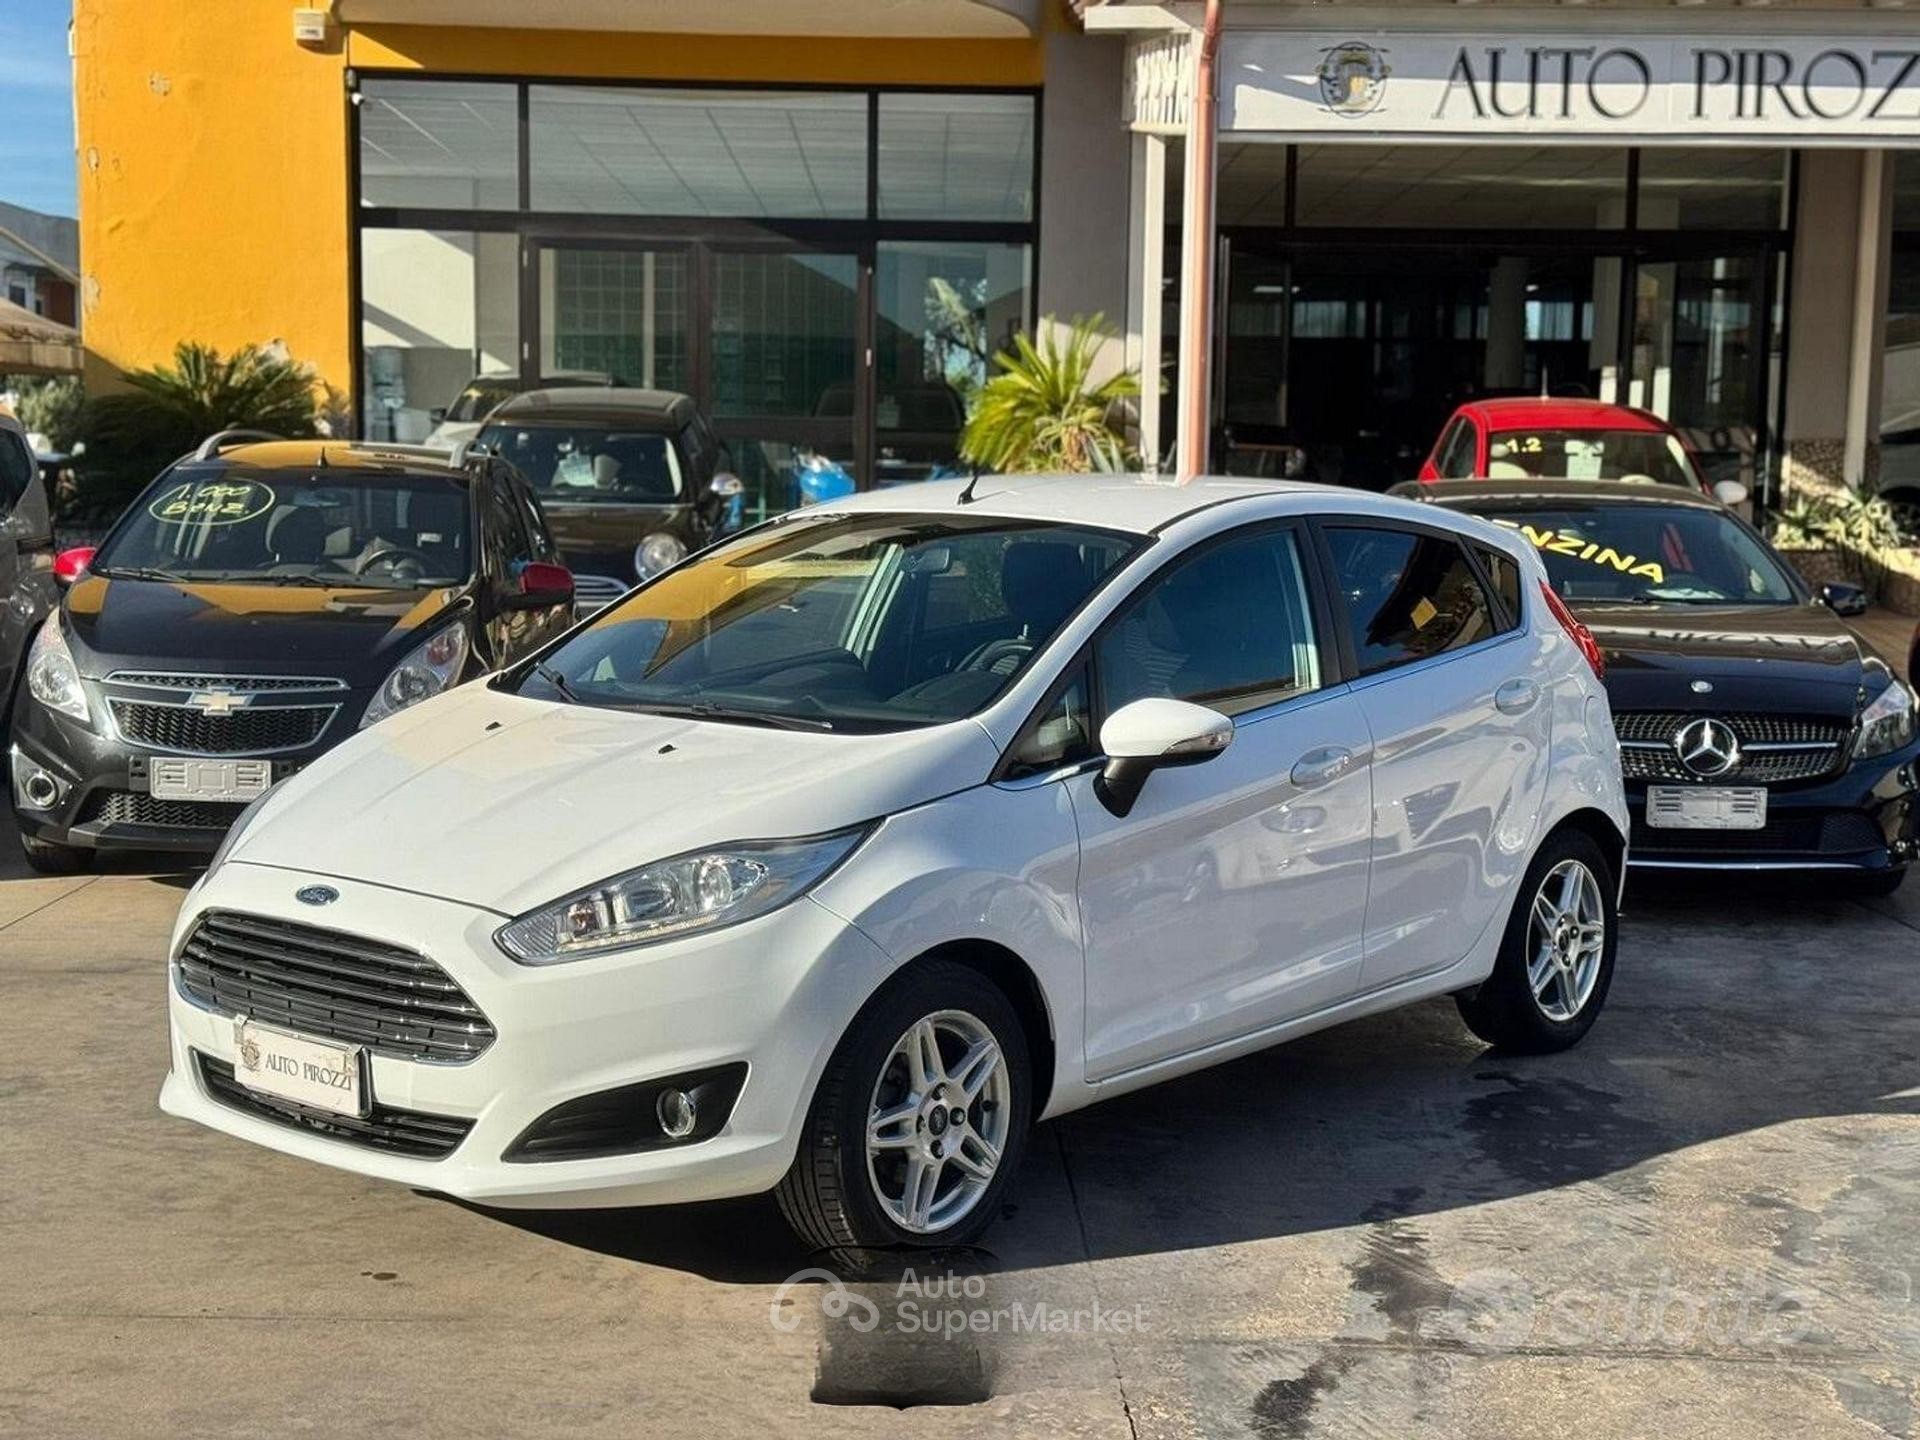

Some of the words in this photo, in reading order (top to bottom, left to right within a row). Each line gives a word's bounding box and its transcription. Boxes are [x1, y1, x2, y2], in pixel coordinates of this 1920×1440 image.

[1430, 46, 1650, 121] AUTO
[1507, 437, 1542, 454] 1.2
[1472, 515, 1664, 583] NZINA
[265, 1053, 299, 1076] AUTO
